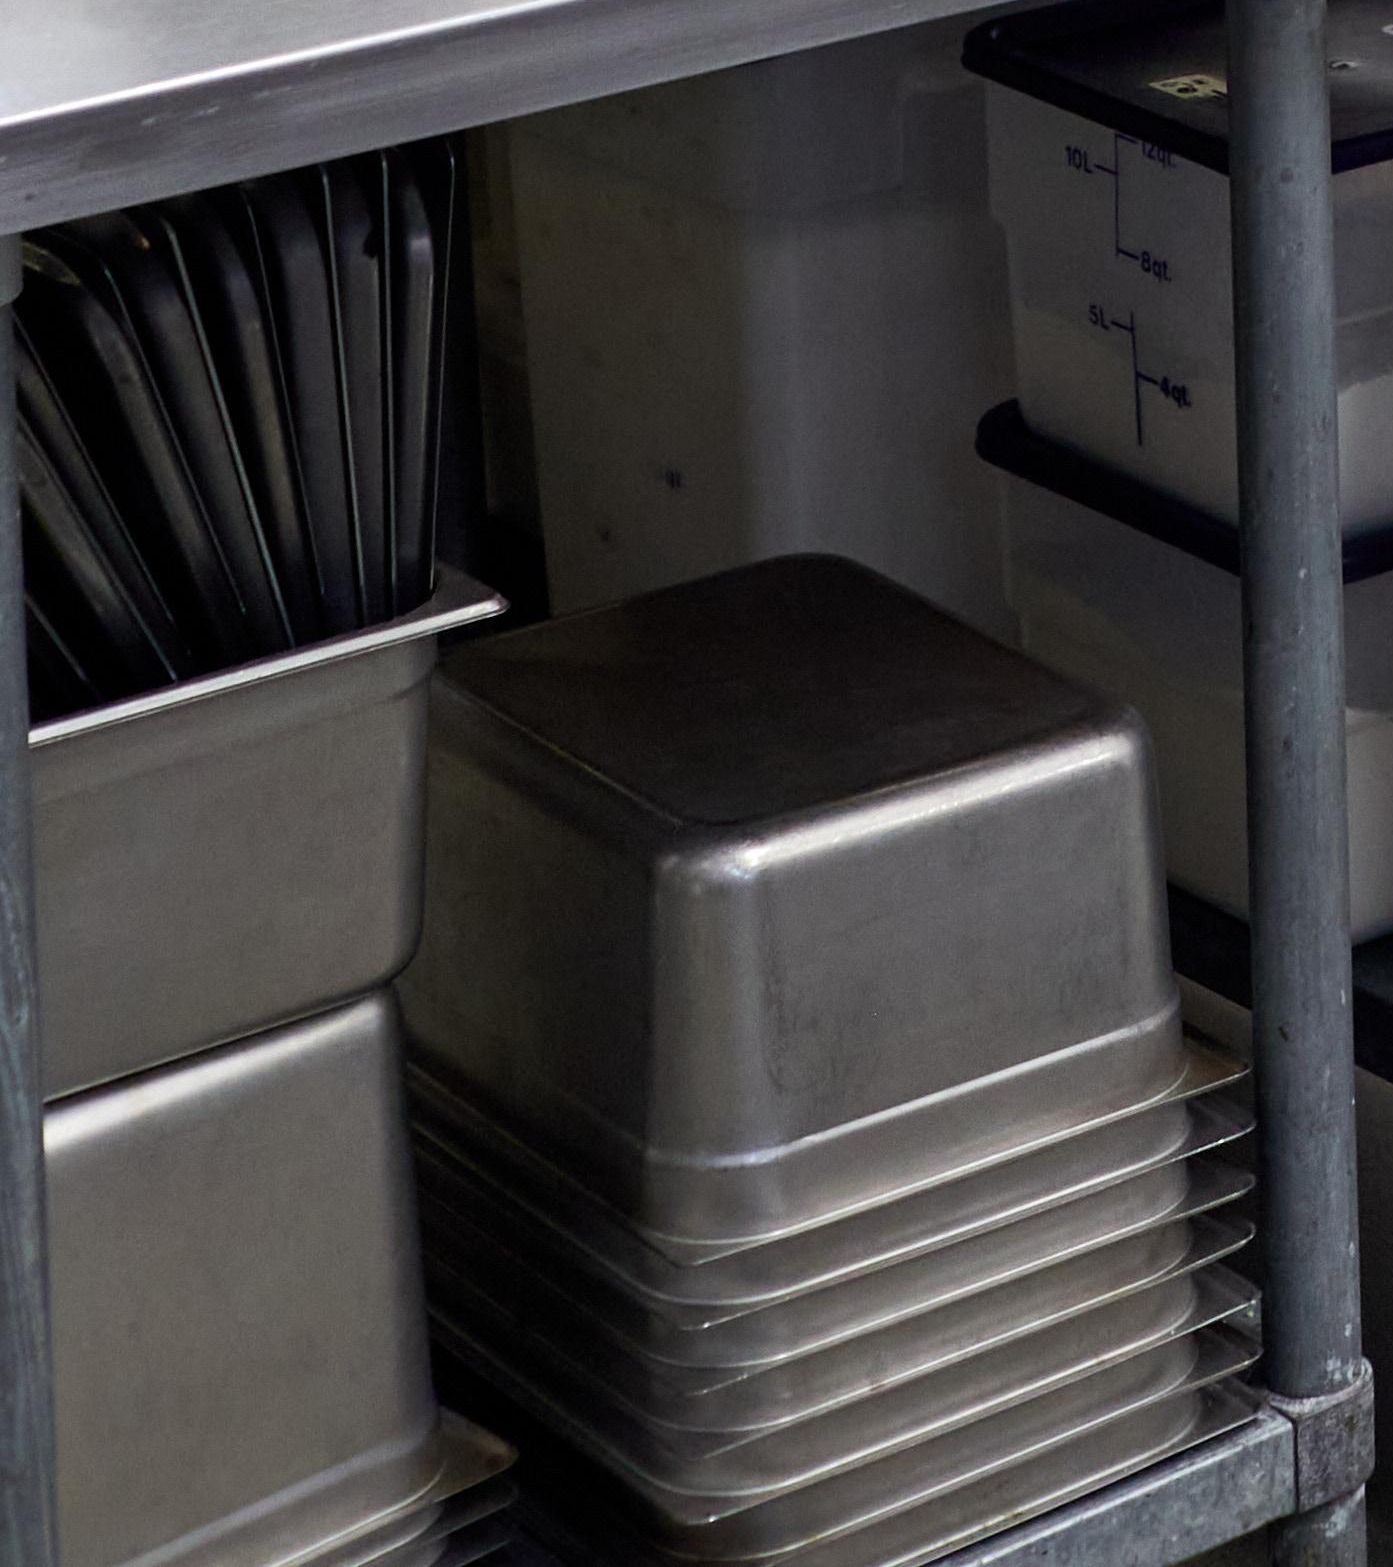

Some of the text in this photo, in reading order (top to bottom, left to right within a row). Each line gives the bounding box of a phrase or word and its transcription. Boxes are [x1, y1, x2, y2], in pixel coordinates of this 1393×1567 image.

[1065, 145, 1092, 174] 10L
[1139, 250, 1172, 282] 8qt.
[1088, 305, 1111, 331] 5L
[1159, 375, 1193, 408] 4qt.
